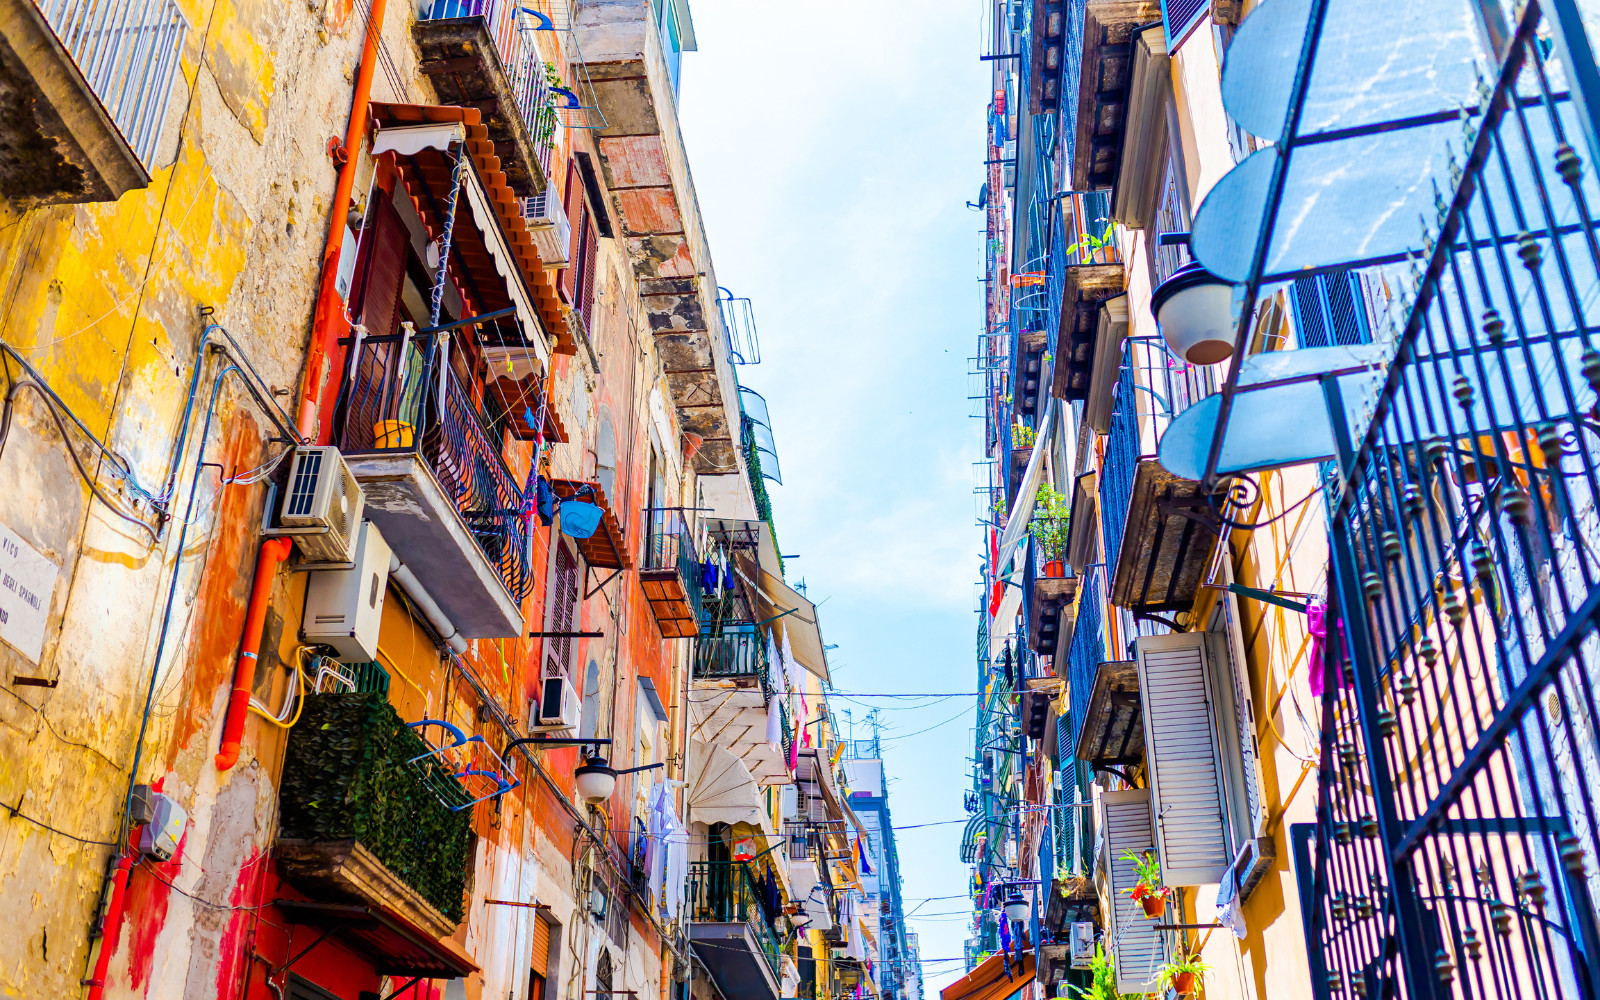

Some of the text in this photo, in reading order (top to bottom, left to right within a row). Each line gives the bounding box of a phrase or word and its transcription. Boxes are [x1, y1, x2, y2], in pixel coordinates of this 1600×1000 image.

[3, 537, 18, 558] VICO
[3, 573, 41, 611] DEGLI SPAGNOLI
